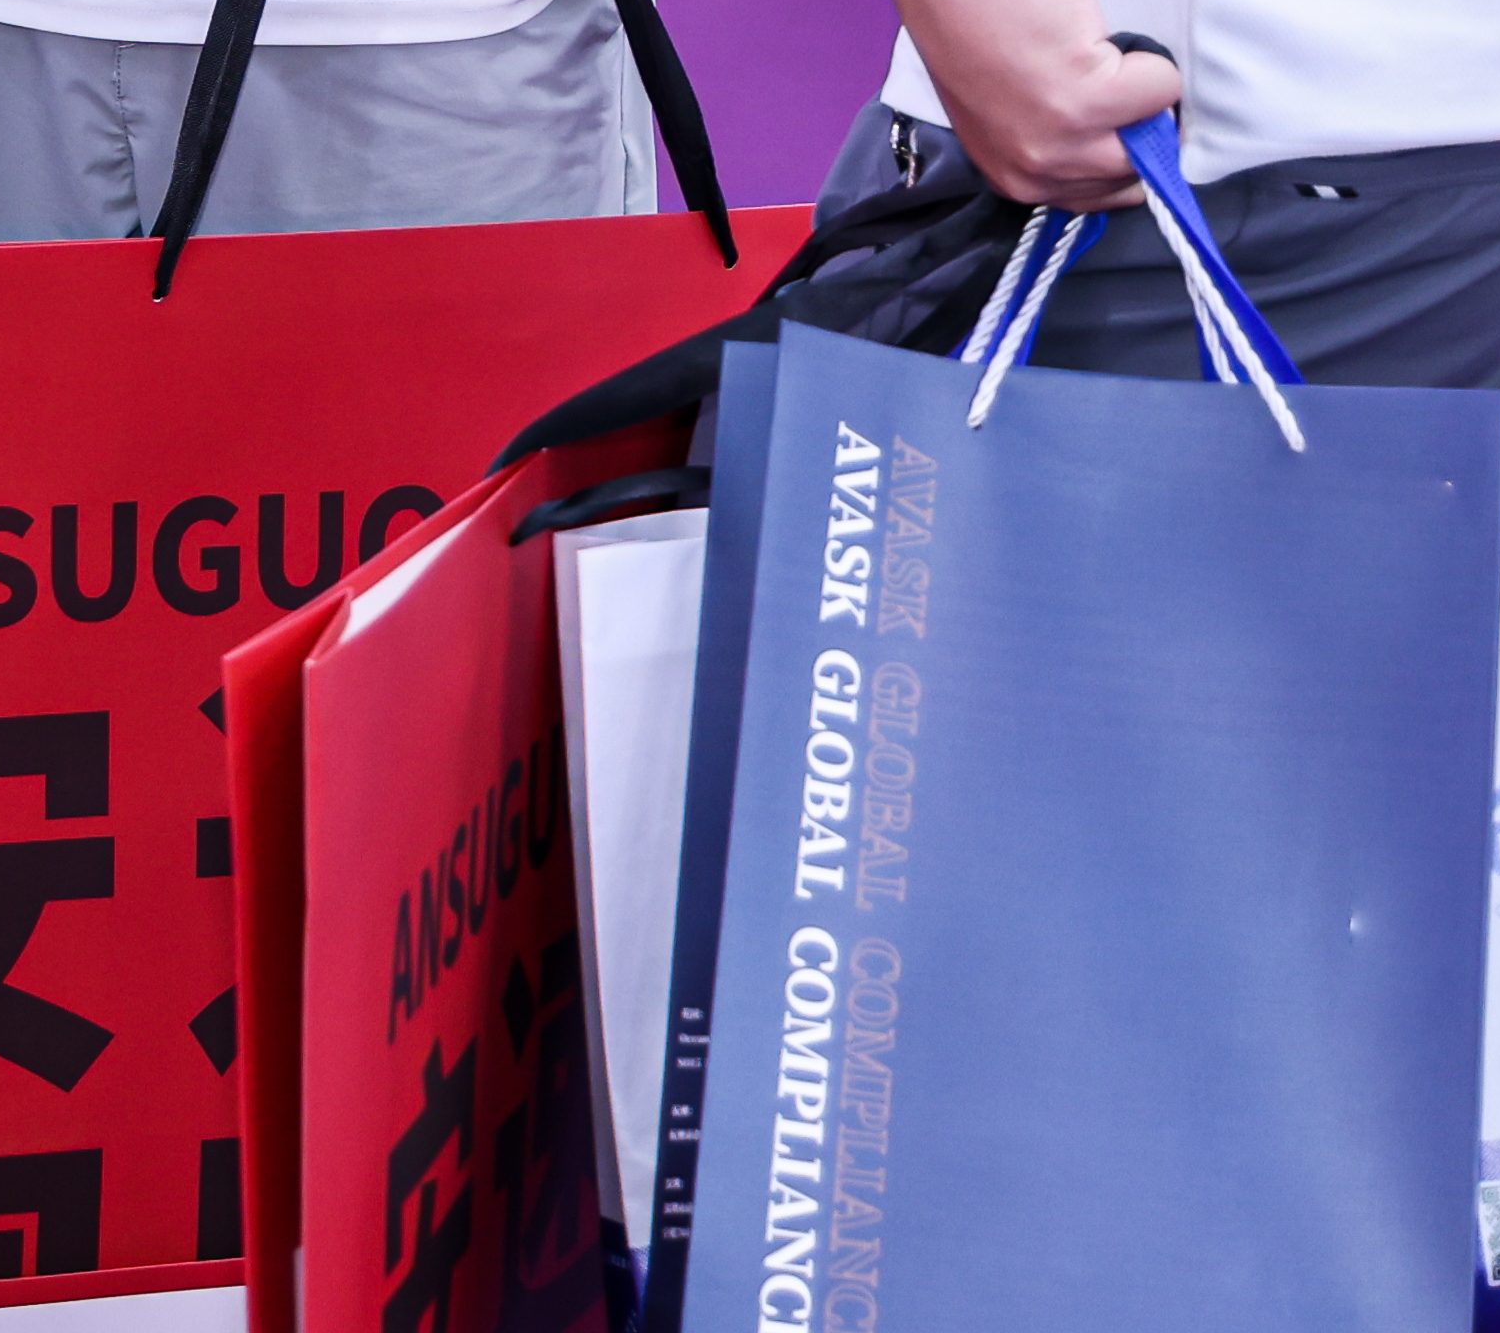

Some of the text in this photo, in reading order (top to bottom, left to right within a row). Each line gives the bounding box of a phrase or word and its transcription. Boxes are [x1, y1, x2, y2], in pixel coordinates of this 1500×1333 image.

[818, 421, 882, 627] AVASK
[793, 648, 862, 902] GLOBAL
[823, 435, 938, 1333] AVASK GLOBAL COMPLIANC
